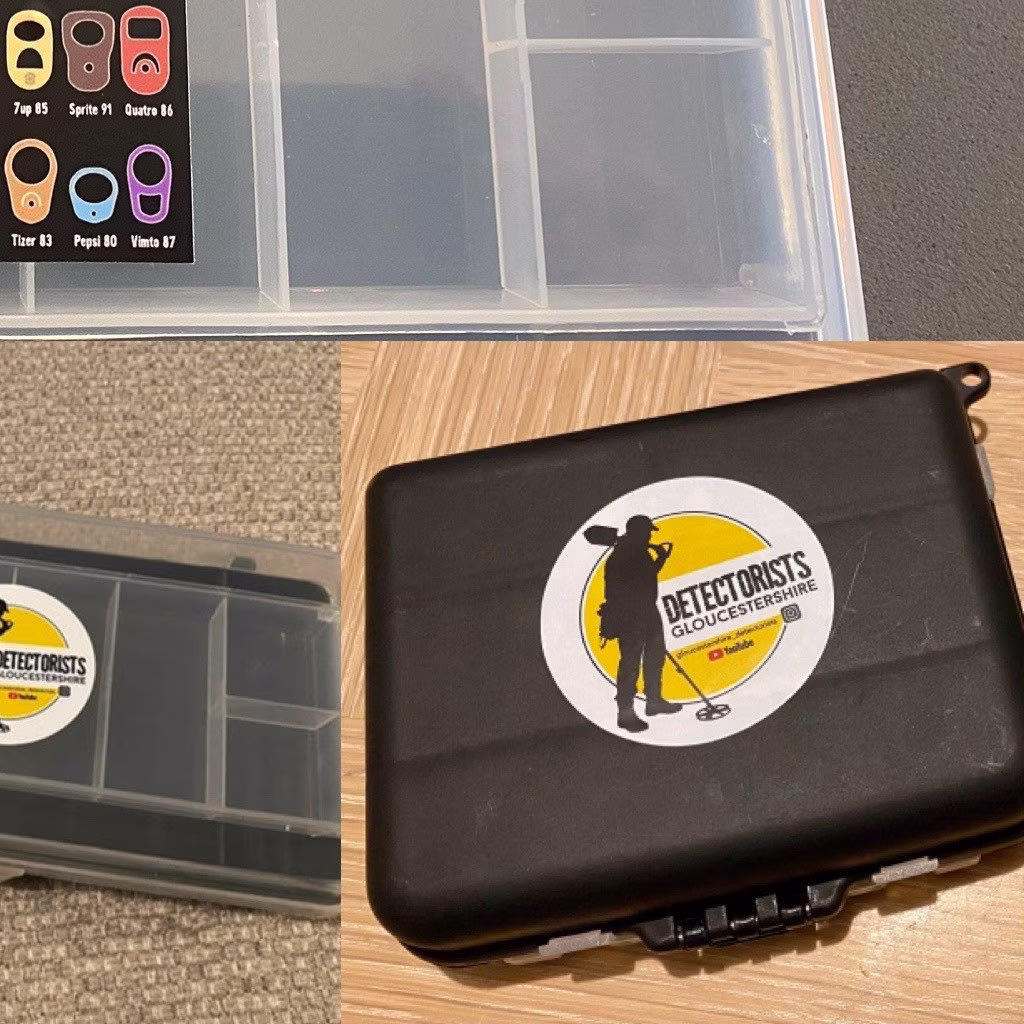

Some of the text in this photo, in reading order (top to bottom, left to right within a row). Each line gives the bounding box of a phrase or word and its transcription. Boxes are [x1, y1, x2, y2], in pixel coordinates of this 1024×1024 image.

[14, 102, 48, 115] 7up 85
[69, 102, 112, 116] Sprite 91
[125, 103, 173, 116] Quatro 86
[11, 234, 52, 246] Tizer 83
[74, 234, 117, 248] Pepsi 80
[131, 235, 175, 248] Vimto 87
[662, 551, 812, 624] DETECTORISTS
[671, 579, 818, 639] GLOUCESTERSHIRE
[724, 639, 754, 655] YouTube
